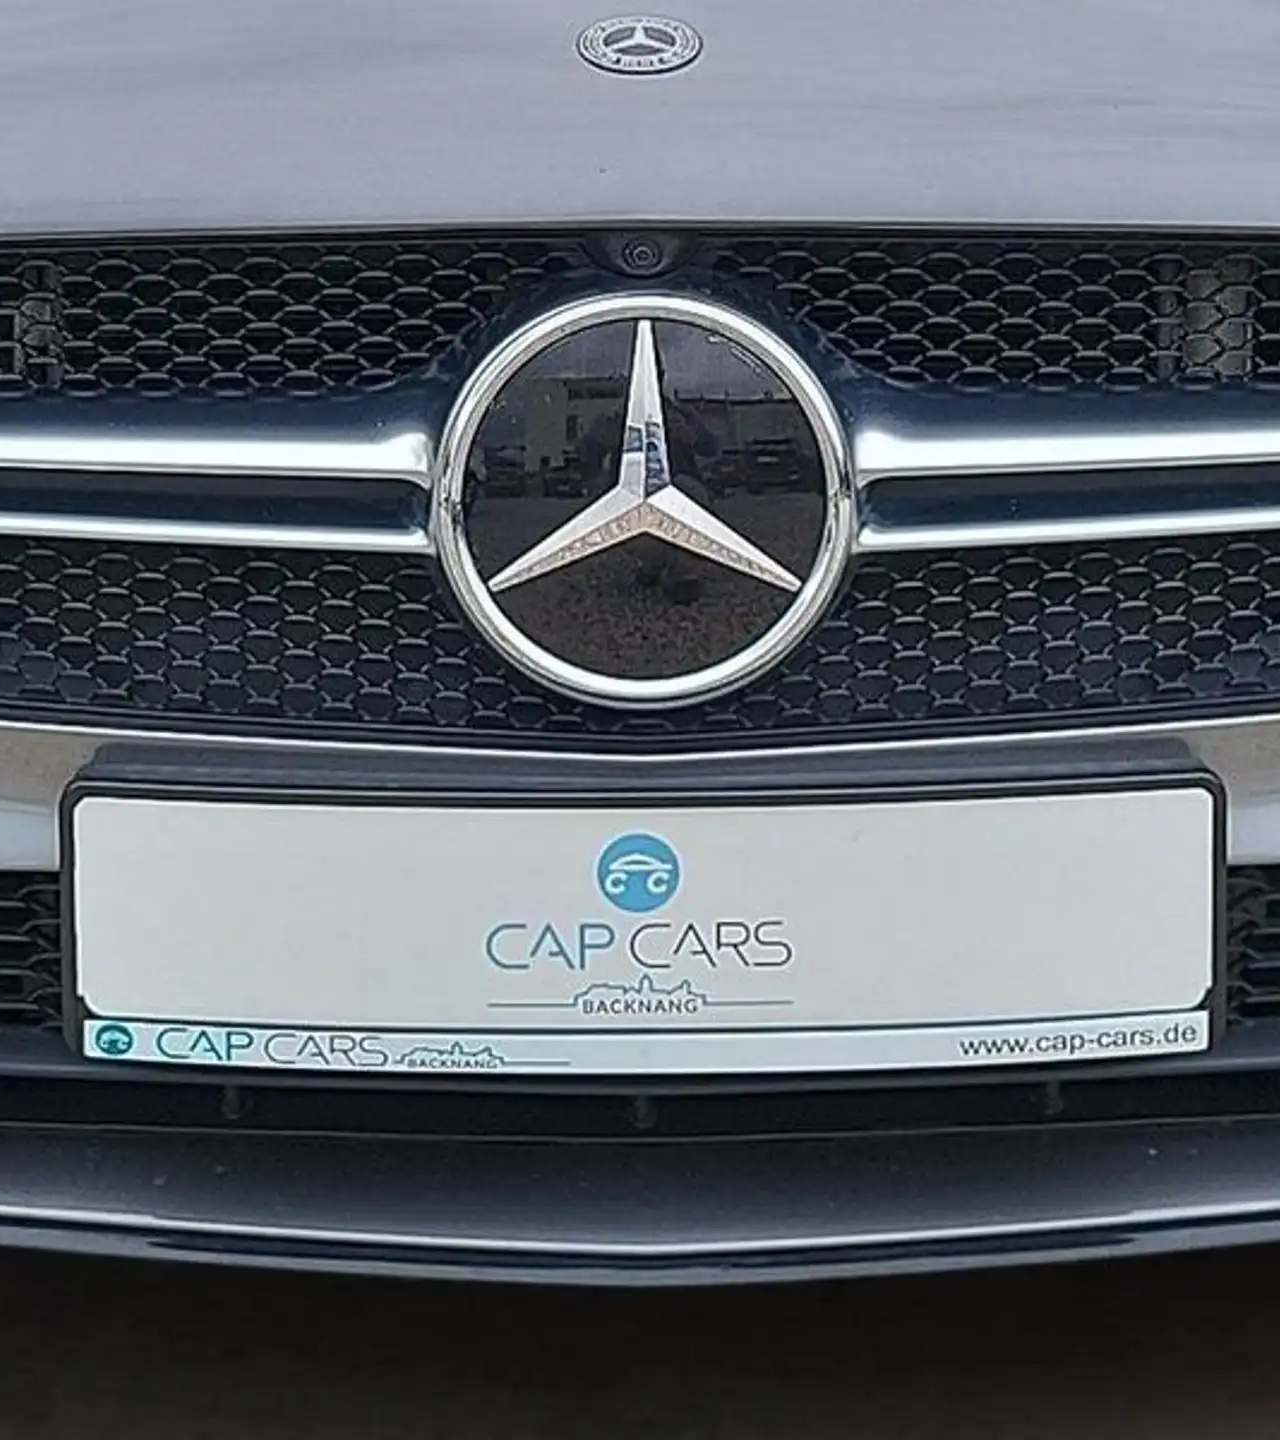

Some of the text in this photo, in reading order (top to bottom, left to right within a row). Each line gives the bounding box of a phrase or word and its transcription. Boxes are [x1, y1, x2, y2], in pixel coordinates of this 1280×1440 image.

[486, 921, 793, 970] CAP CARS
[582, 997, 699, 1015] BACKNANG
[156, 1027, 254, 1062] CAP
[264, 1033, 389, 1067] CARS
[959, 1023, 1197, 1056] www.cap-cars.de
